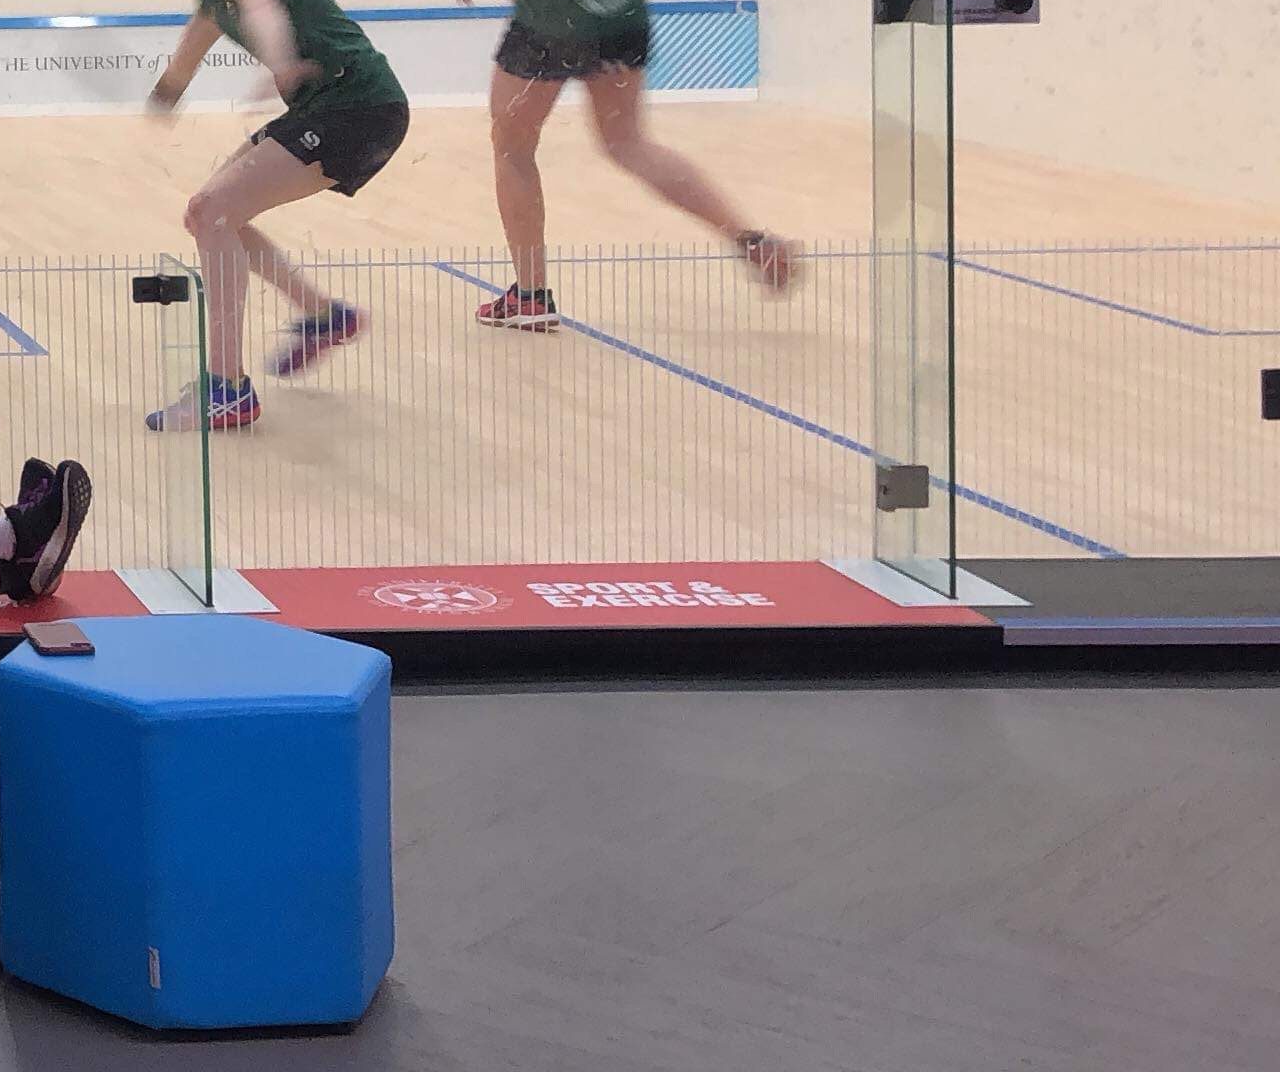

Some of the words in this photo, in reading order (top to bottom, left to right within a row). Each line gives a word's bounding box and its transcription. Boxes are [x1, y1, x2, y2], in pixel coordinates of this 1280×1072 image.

[35, 54, 147, 71] UNIVERSITY
[147, 54, 162, 74] of
[526, 581, 676, 596] SPORT
[687, 580, 729, 594] &
[542, 592, 777, 608] EXERCISE
